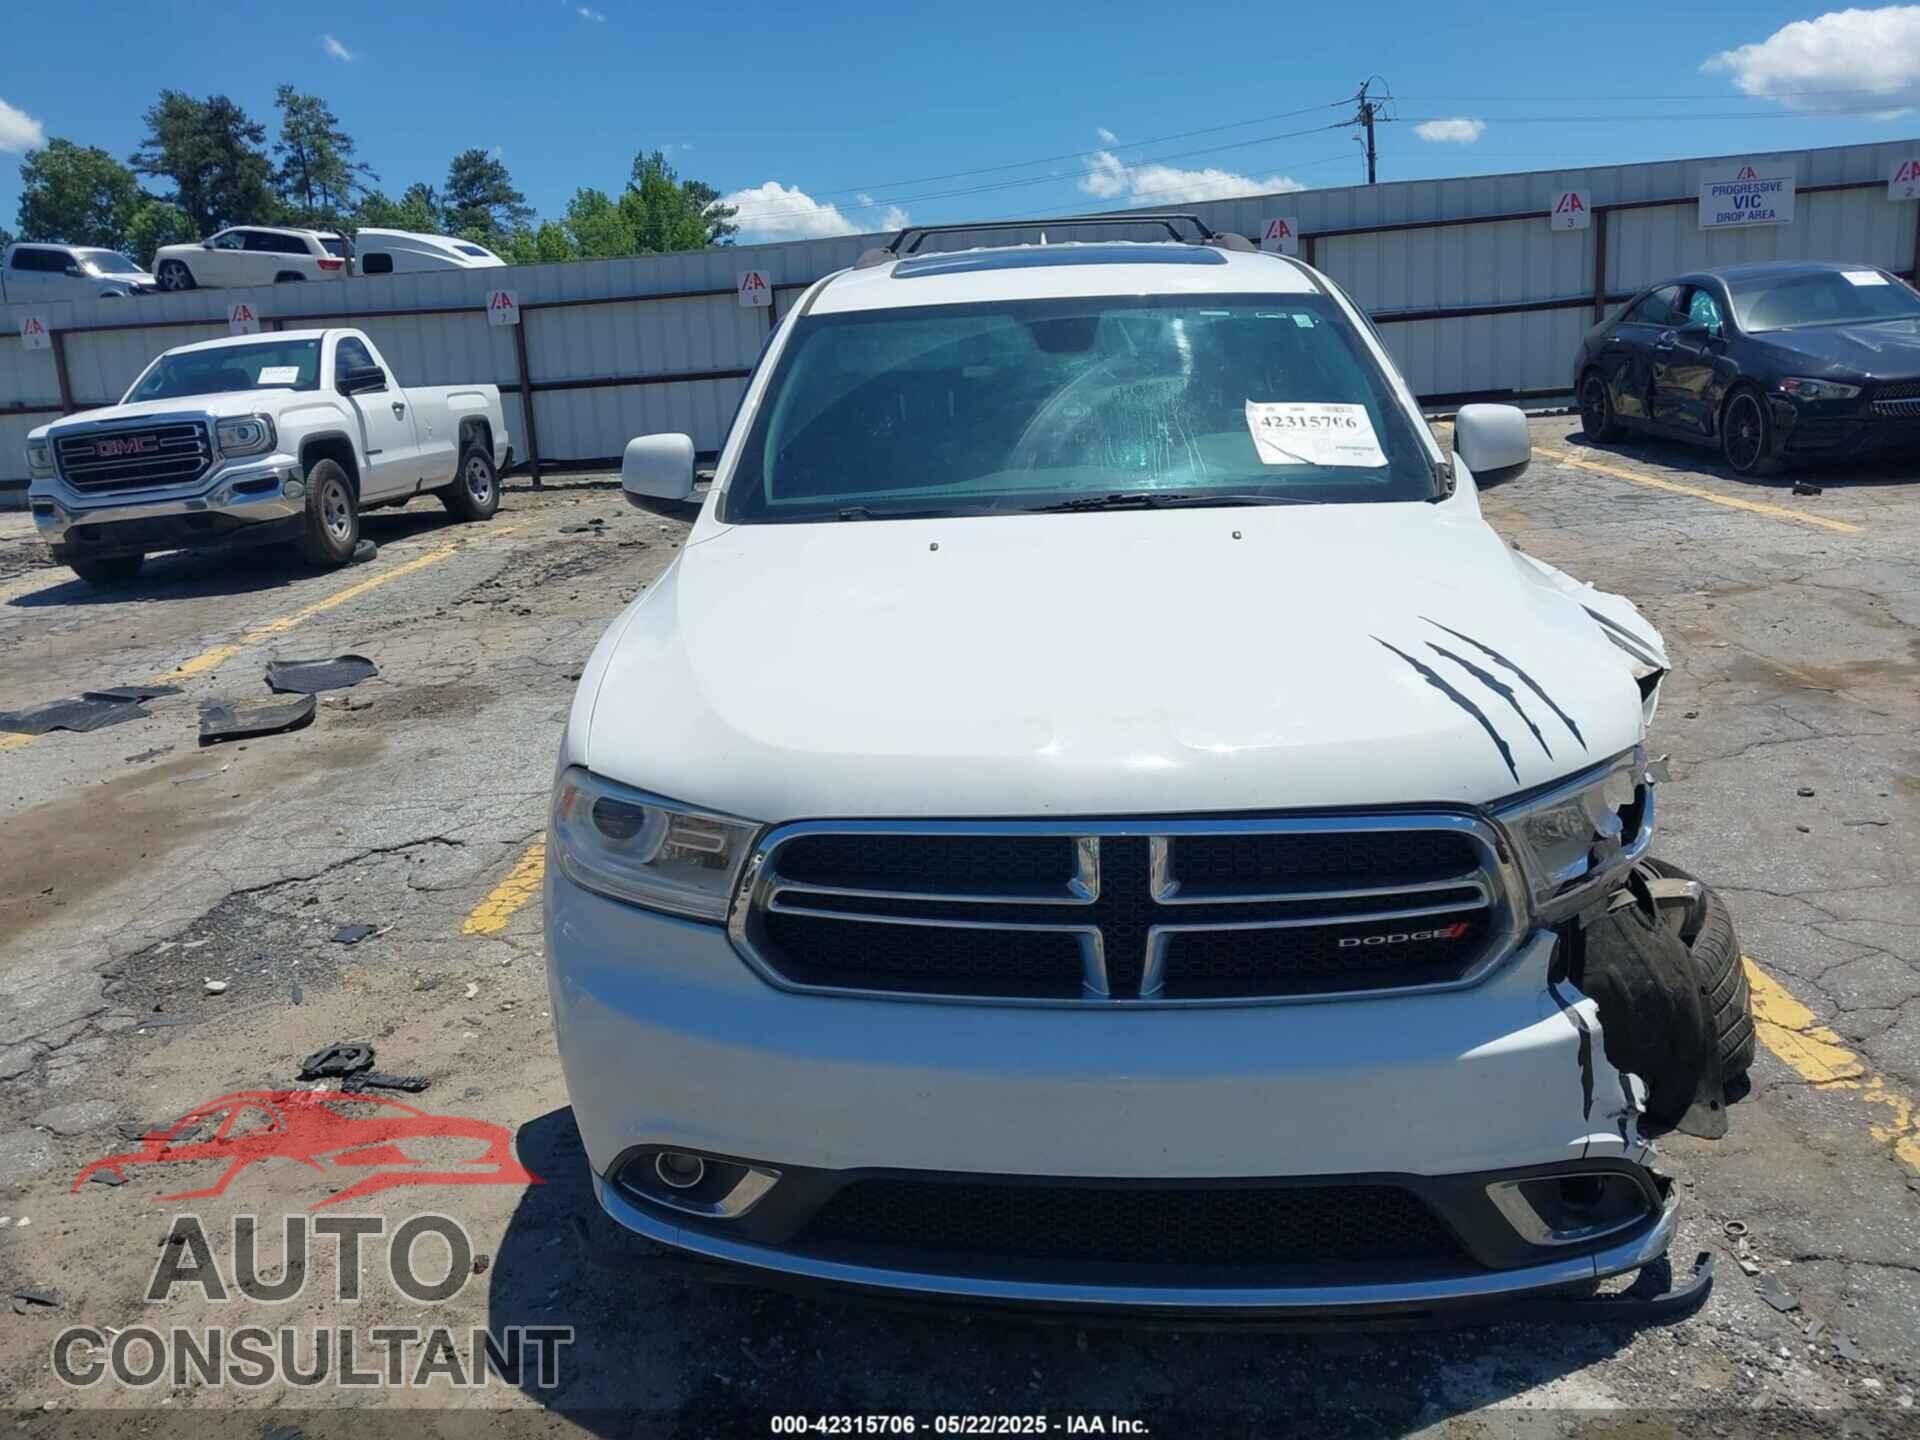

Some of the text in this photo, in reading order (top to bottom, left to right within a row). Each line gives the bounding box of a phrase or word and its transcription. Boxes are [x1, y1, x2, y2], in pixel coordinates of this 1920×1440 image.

[1711, 181, 1784, 196] PROGRESSIVE
[1733, 194, 1762, 209] VIC
[1567, 217, 1576, 228] 3
[1716, 209, 1776, 223] DROP AREA
[96, 435, 159, 457] GMC
[1338, 928, 1454, 947] DODGE
